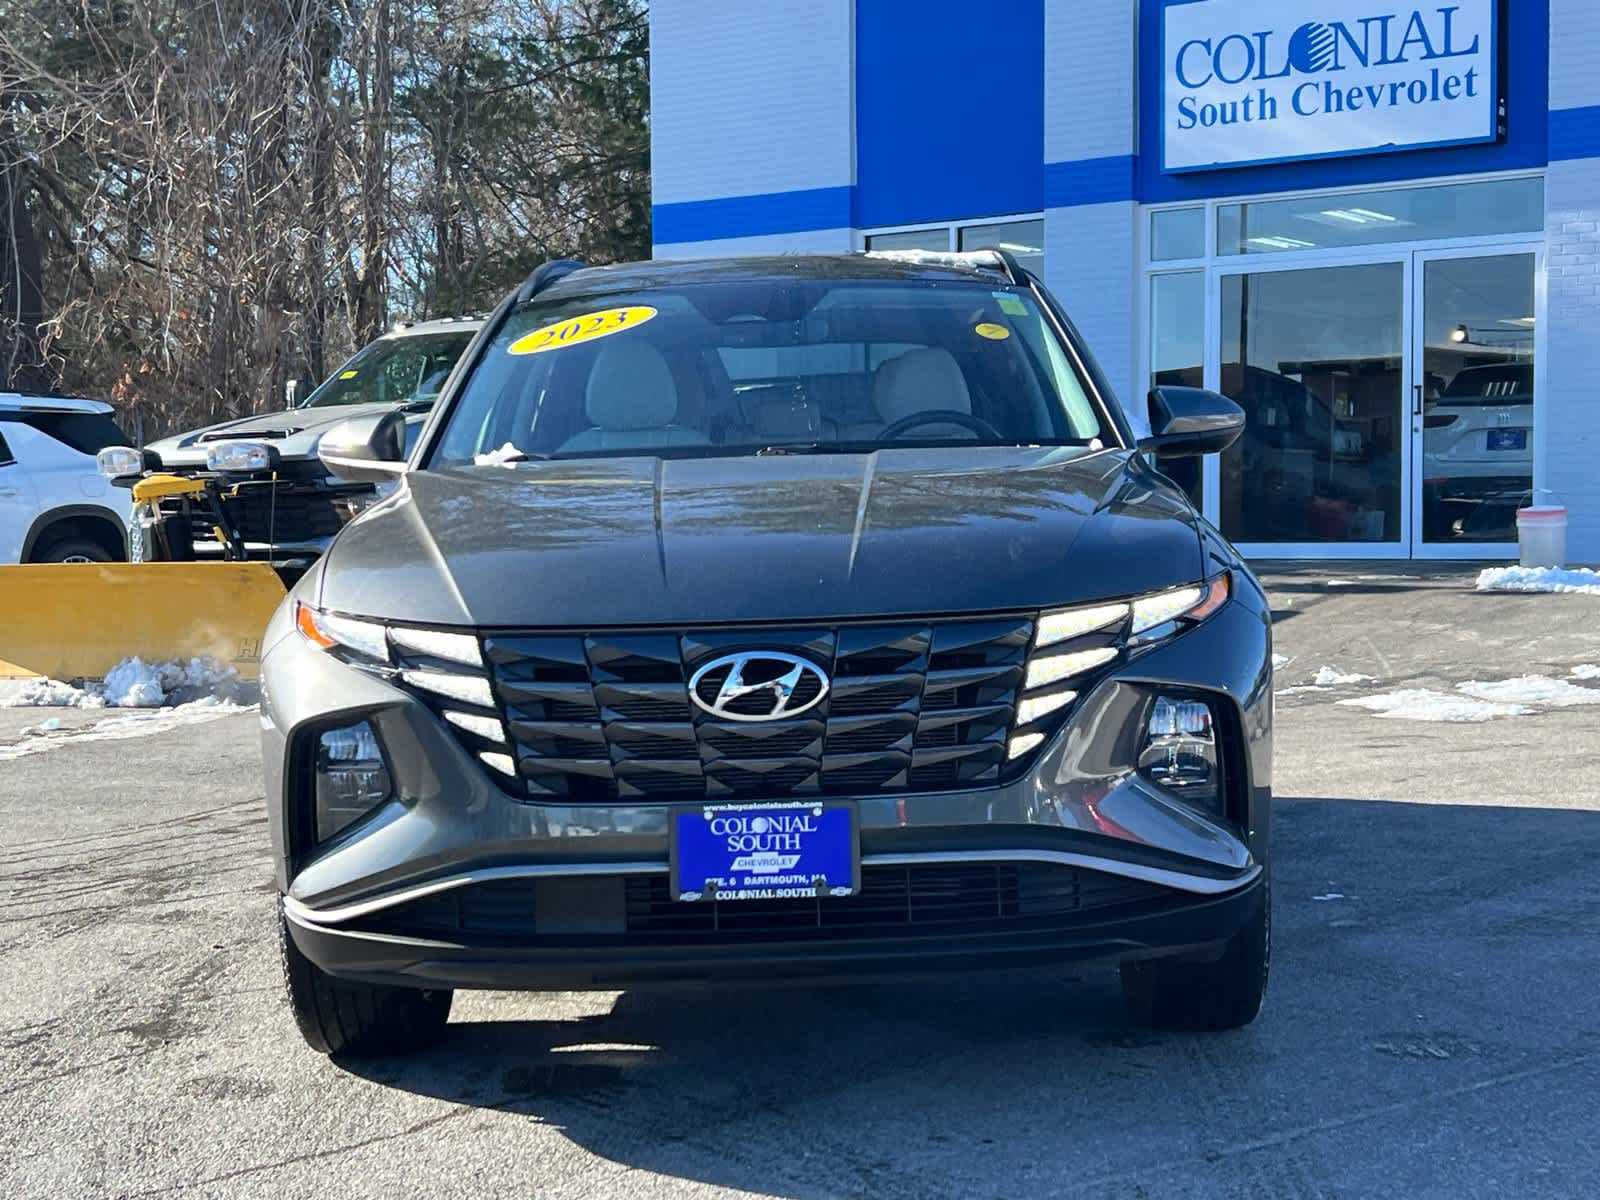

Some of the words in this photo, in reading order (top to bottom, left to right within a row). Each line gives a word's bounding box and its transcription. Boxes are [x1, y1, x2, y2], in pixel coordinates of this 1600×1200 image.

[1175, 7, 1479, 89] COLONIAL
[1177, 88, 1277, 130] South
[1291, 66, 1478, 116] Chevrolet
[537, 311, 628, 348] 2023
[710, 815, 818, 835] COLONIAL
[727, 833, 801, 853] SOUTH
[737, 857, 793, 867] CHEVROLET
[729, 877, 737, 886] 6
[744, 874, 809, 886] DARTMOUTH,
[715, 888, 776, 900] COLONIAL
[776, 887, 816, 898] SOUTH
